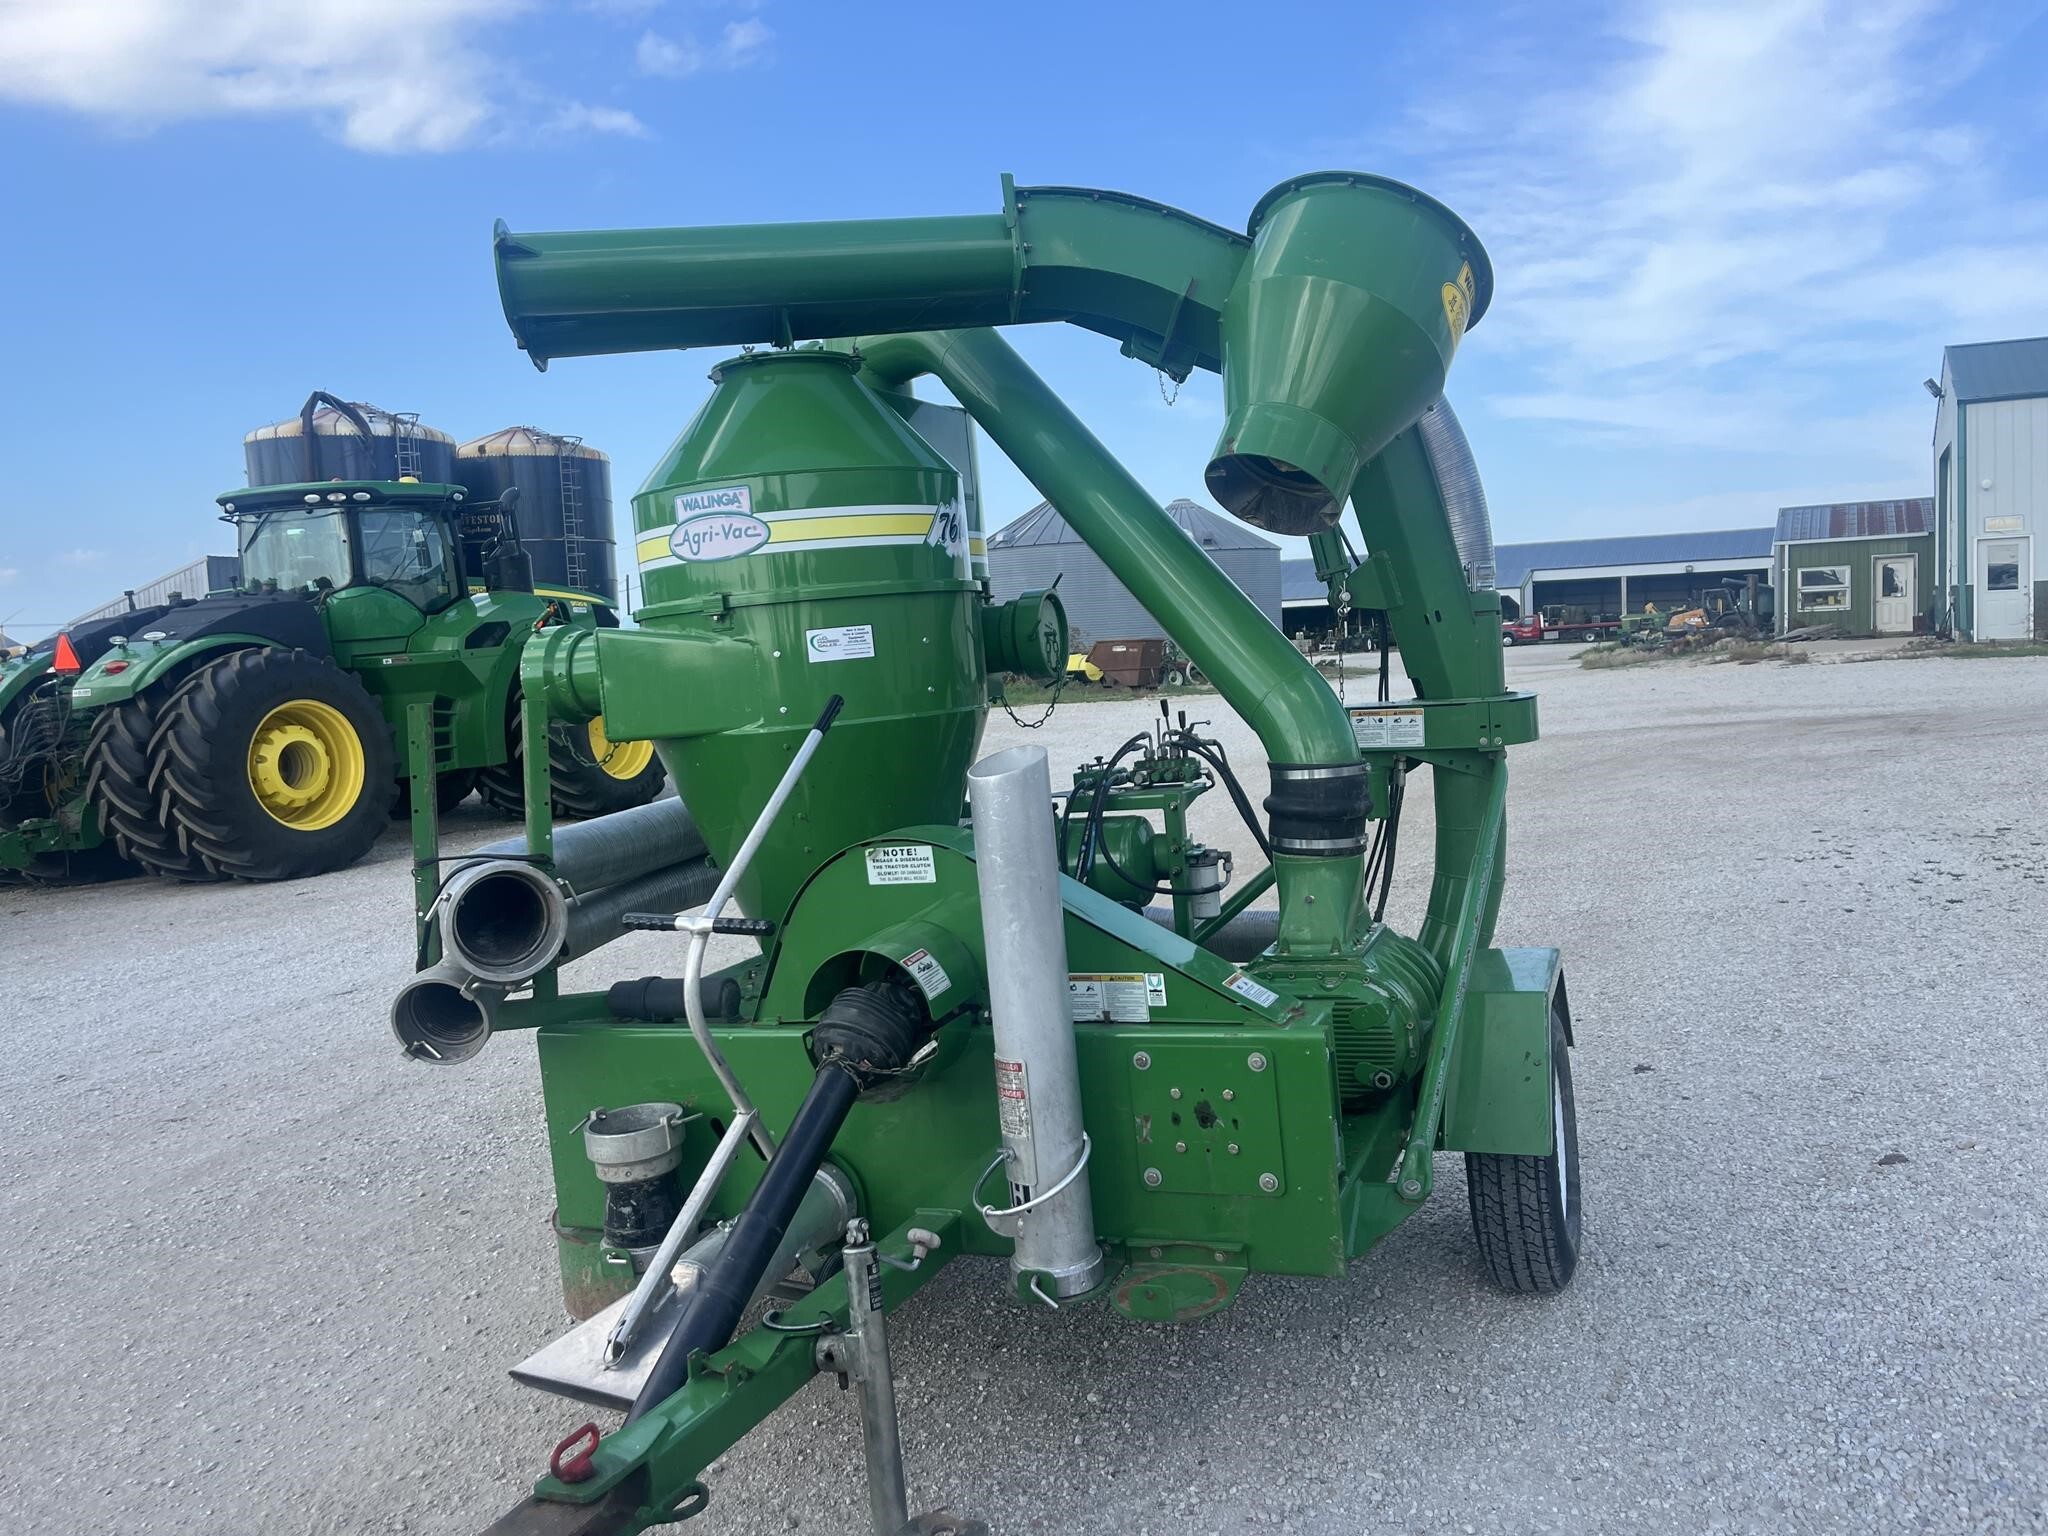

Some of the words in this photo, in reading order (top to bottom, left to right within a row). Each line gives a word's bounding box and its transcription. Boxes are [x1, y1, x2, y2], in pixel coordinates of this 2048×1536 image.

[681, 491, 742, 512] WALINGA
[674, 523, 762, 556] Agri-Vac
[939, 512, 961, 544] 76
[883, 848, 918, 857] NOTE!
